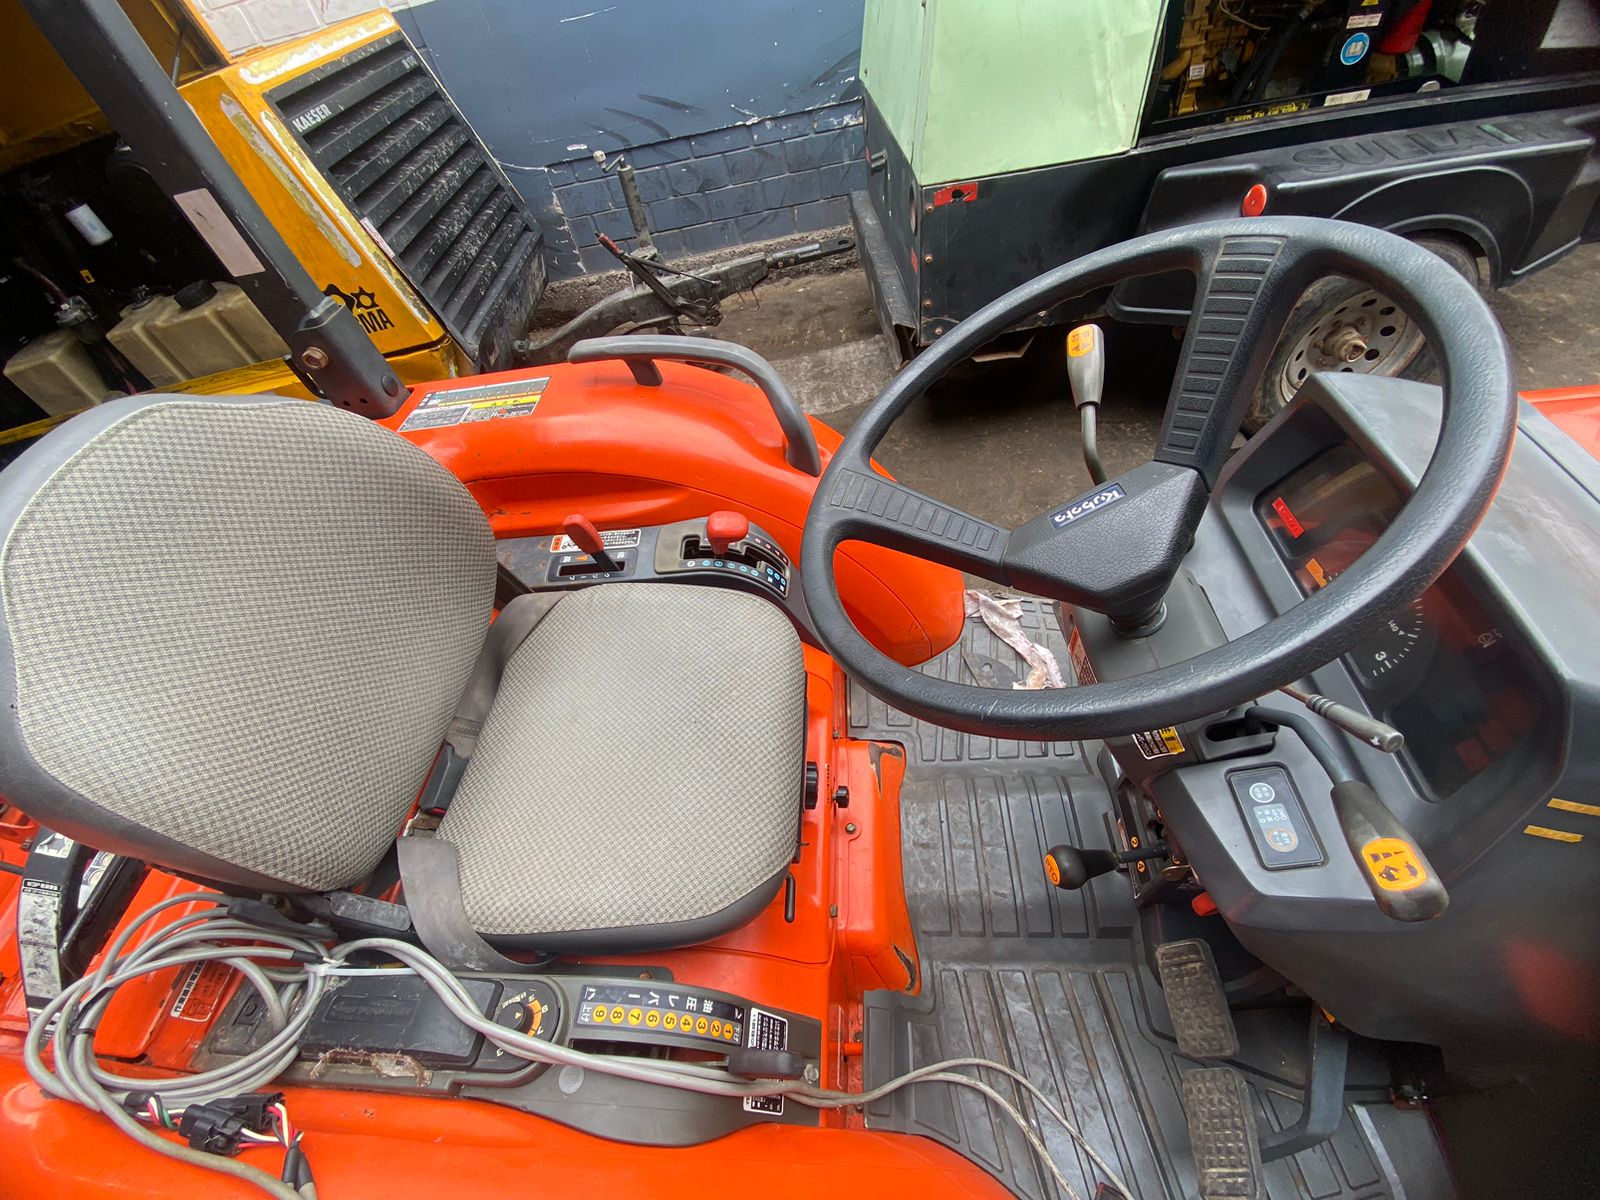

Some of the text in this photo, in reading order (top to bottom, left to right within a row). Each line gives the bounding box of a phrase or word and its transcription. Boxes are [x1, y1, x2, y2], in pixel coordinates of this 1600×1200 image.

[291, 104, 333, 133] KAESER
[1293, 117, 1550, 172] SULLAIR
[1054, 489, 1120, 523] Kubota
[1375, 651, 1387, 661] 3
